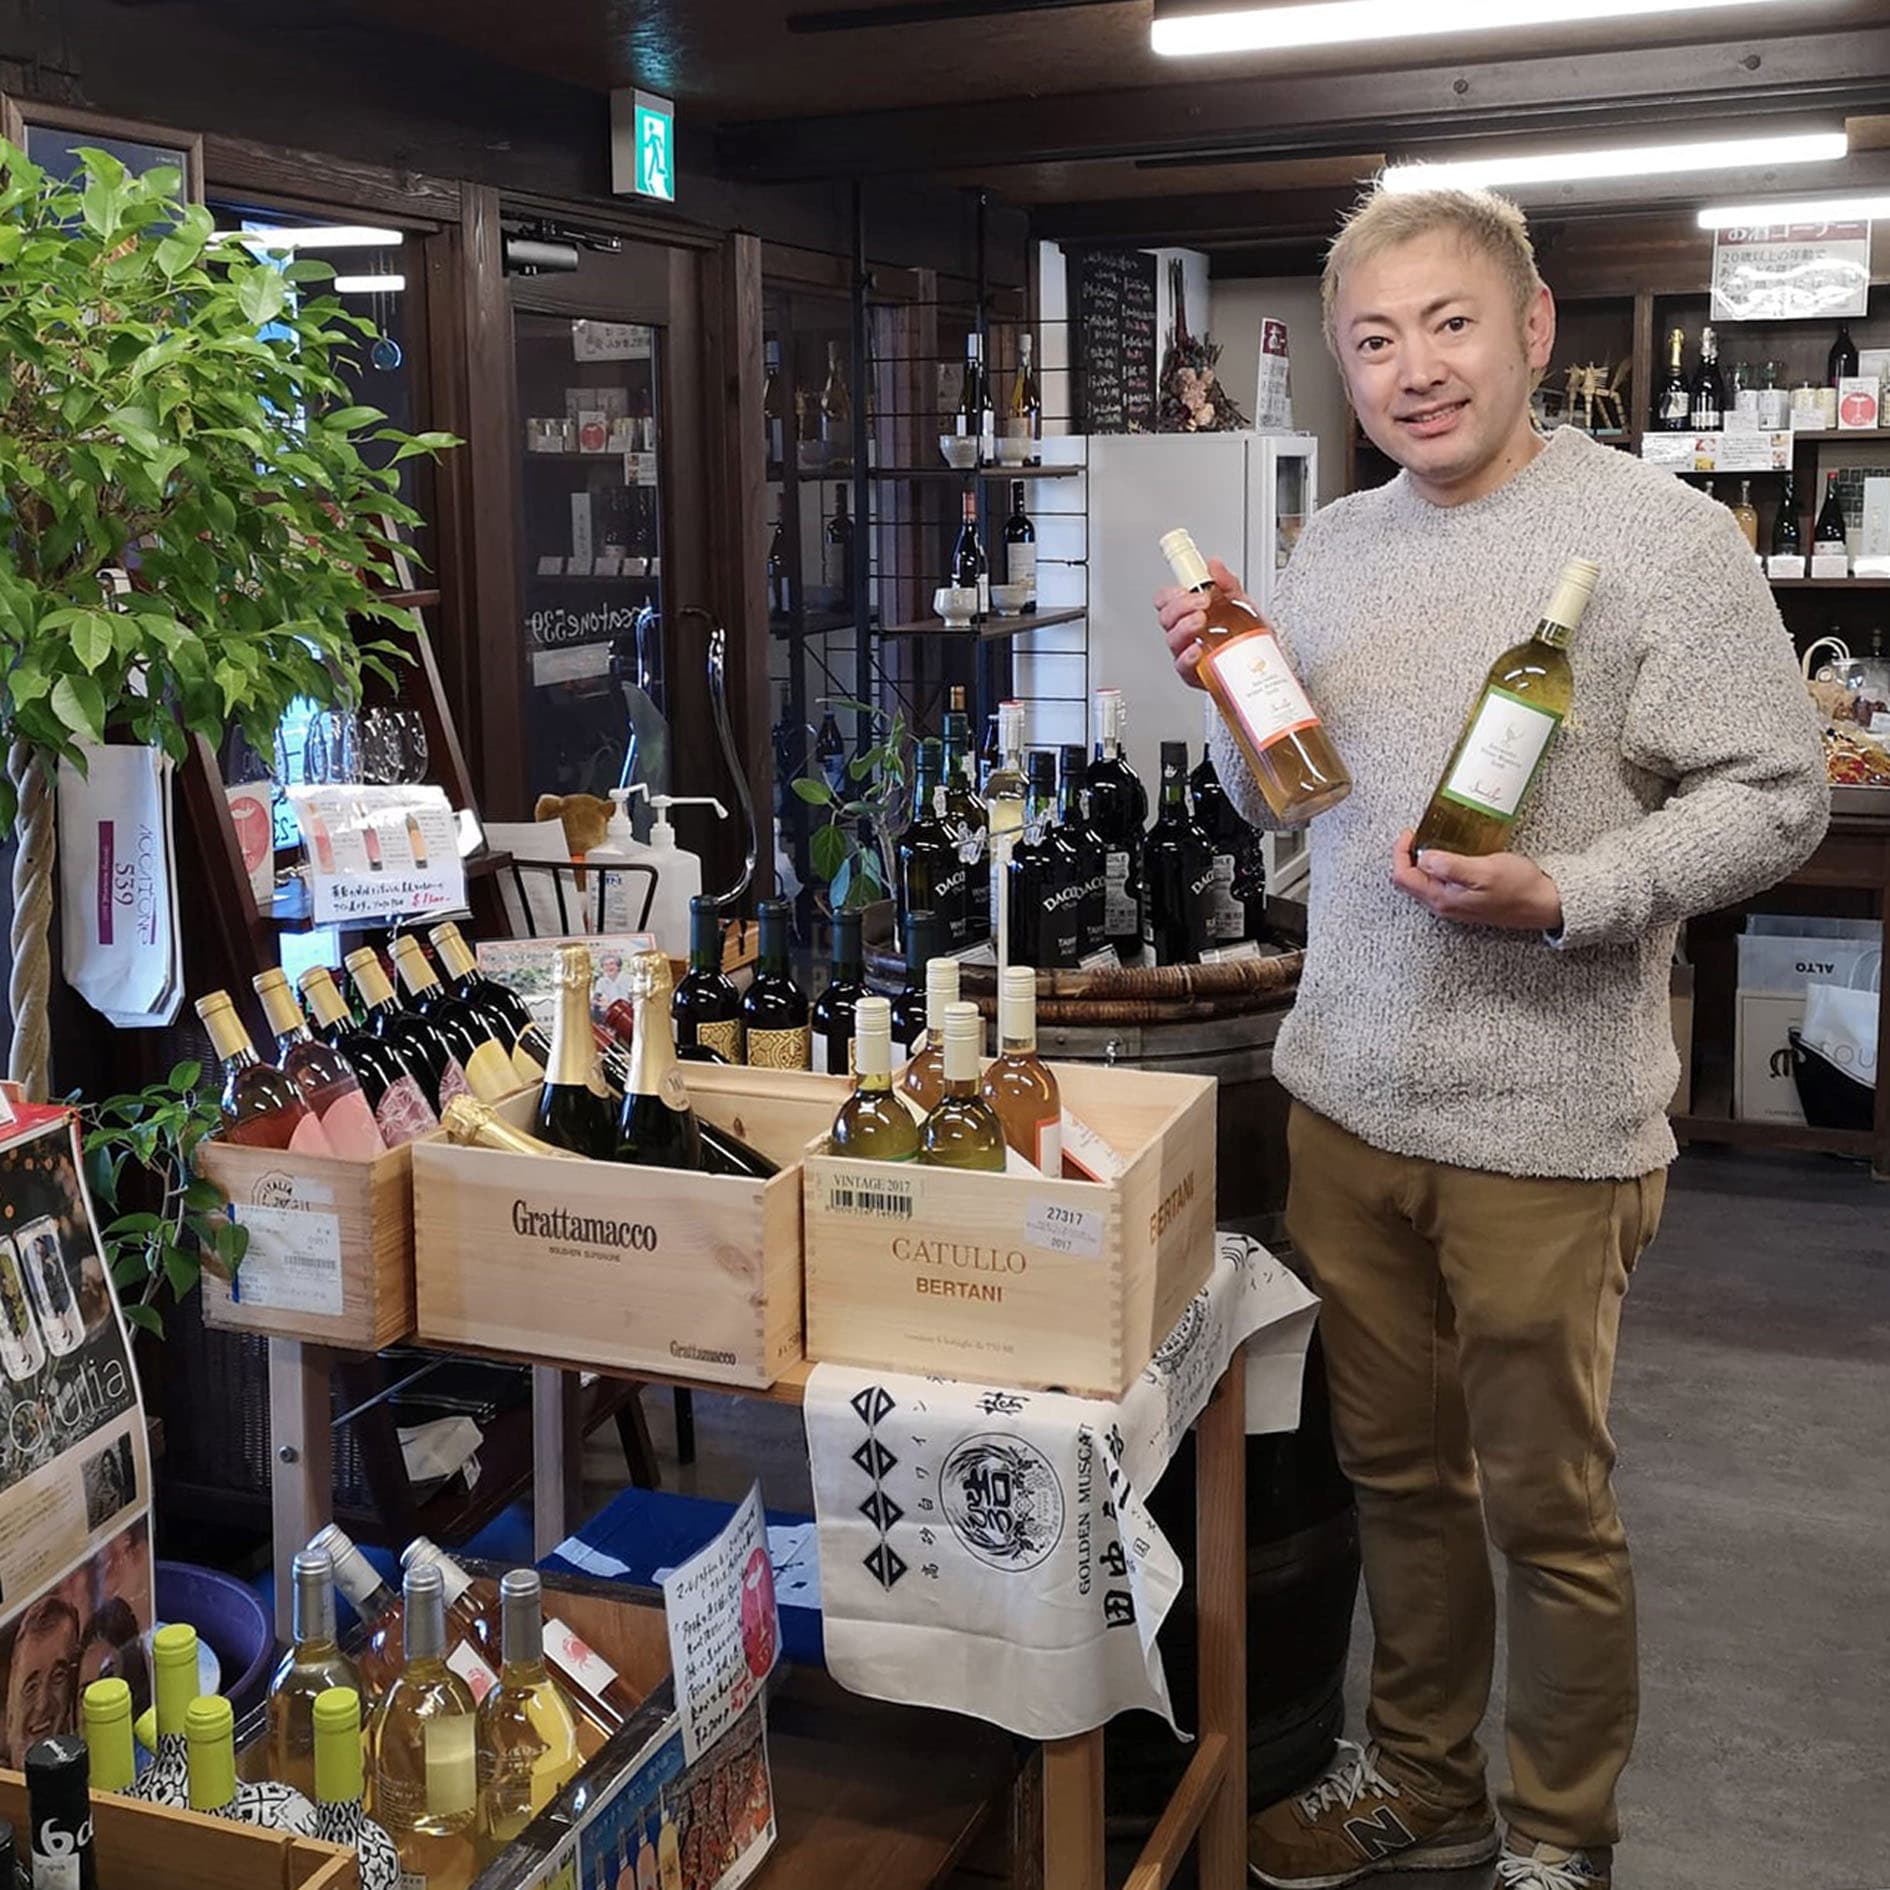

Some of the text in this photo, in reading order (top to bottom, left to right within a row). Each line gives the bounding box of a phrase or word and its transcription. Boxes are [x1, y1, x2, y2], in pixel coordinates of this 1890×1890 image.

[114, 862, 136, 906] 539
[1796, 962, 1834, 974] ALTO
[833, 1173, 911, 1192] VINTAGE 2017
[511, 1199, 658, 1252] Grattamacco
[1046, 1206, 1084, 1226] 27317
[1149, 1170, 1194, 1247] BERTANI
[891, 1238, 1028, 1275] CATULLO
[916, 1276, 1003, 1303] BERTANI
[669, 1340, 737, 1366] Grattamacco
[8, 1356, 128, 1455] Giulia
[1076, 1422, 1094, 1596] GOLDEN MUSCAT
[1342, 1804, 1417, 1860] N
